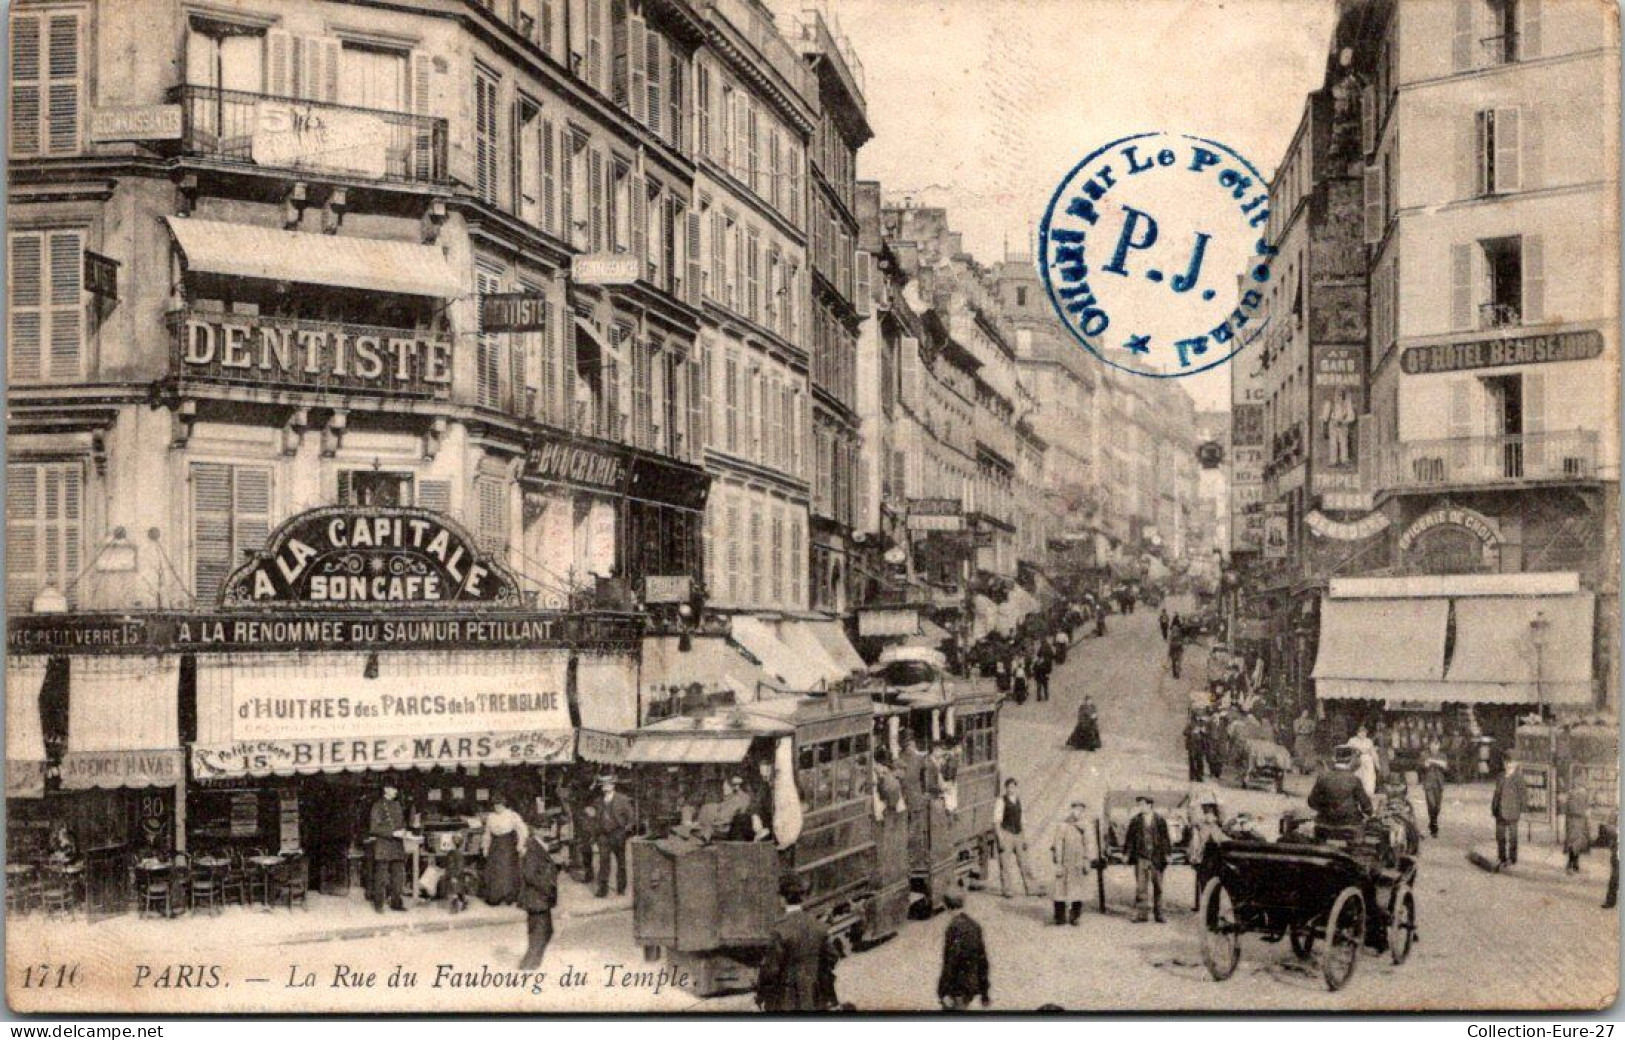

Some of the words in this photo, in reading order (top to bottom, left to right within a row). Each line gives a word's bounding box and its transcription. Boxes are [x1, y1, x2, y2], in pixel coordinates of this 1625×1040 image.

[184, 319, 453, 384] DENTISTE
[253, 570, 276, 600] A
[276, 540, 317, 586] LA
[328, 517, 488, 598] CAPITALE
[310, 576, 368, 601] SON
[37, 627, 70, 645] PETIT
[74, 628, 120, 645] VERRE
[178, 622, 192, 642] A
[201, 621, 223, 643] LA
[233, 621, 344, 643] RENOMMEE
[351, 623, 377, 642] DU
[383, 621, 460, 642] SAUMUR
[466, 620, 553, 642] PETILLANT
[238, 696, 352, 719] d'HUITRES
[353, 700, 379, 718] des
[381, 693, 446, 717] PARCS
[475, 691, 559, 713] TREMBLADE
[292, 738, 388, 765] BIERE
[412, 736, 491, 760] MARS
[68, 757, 121, 776] AGENCE
[125, 755, 174, 776] HAVAS
